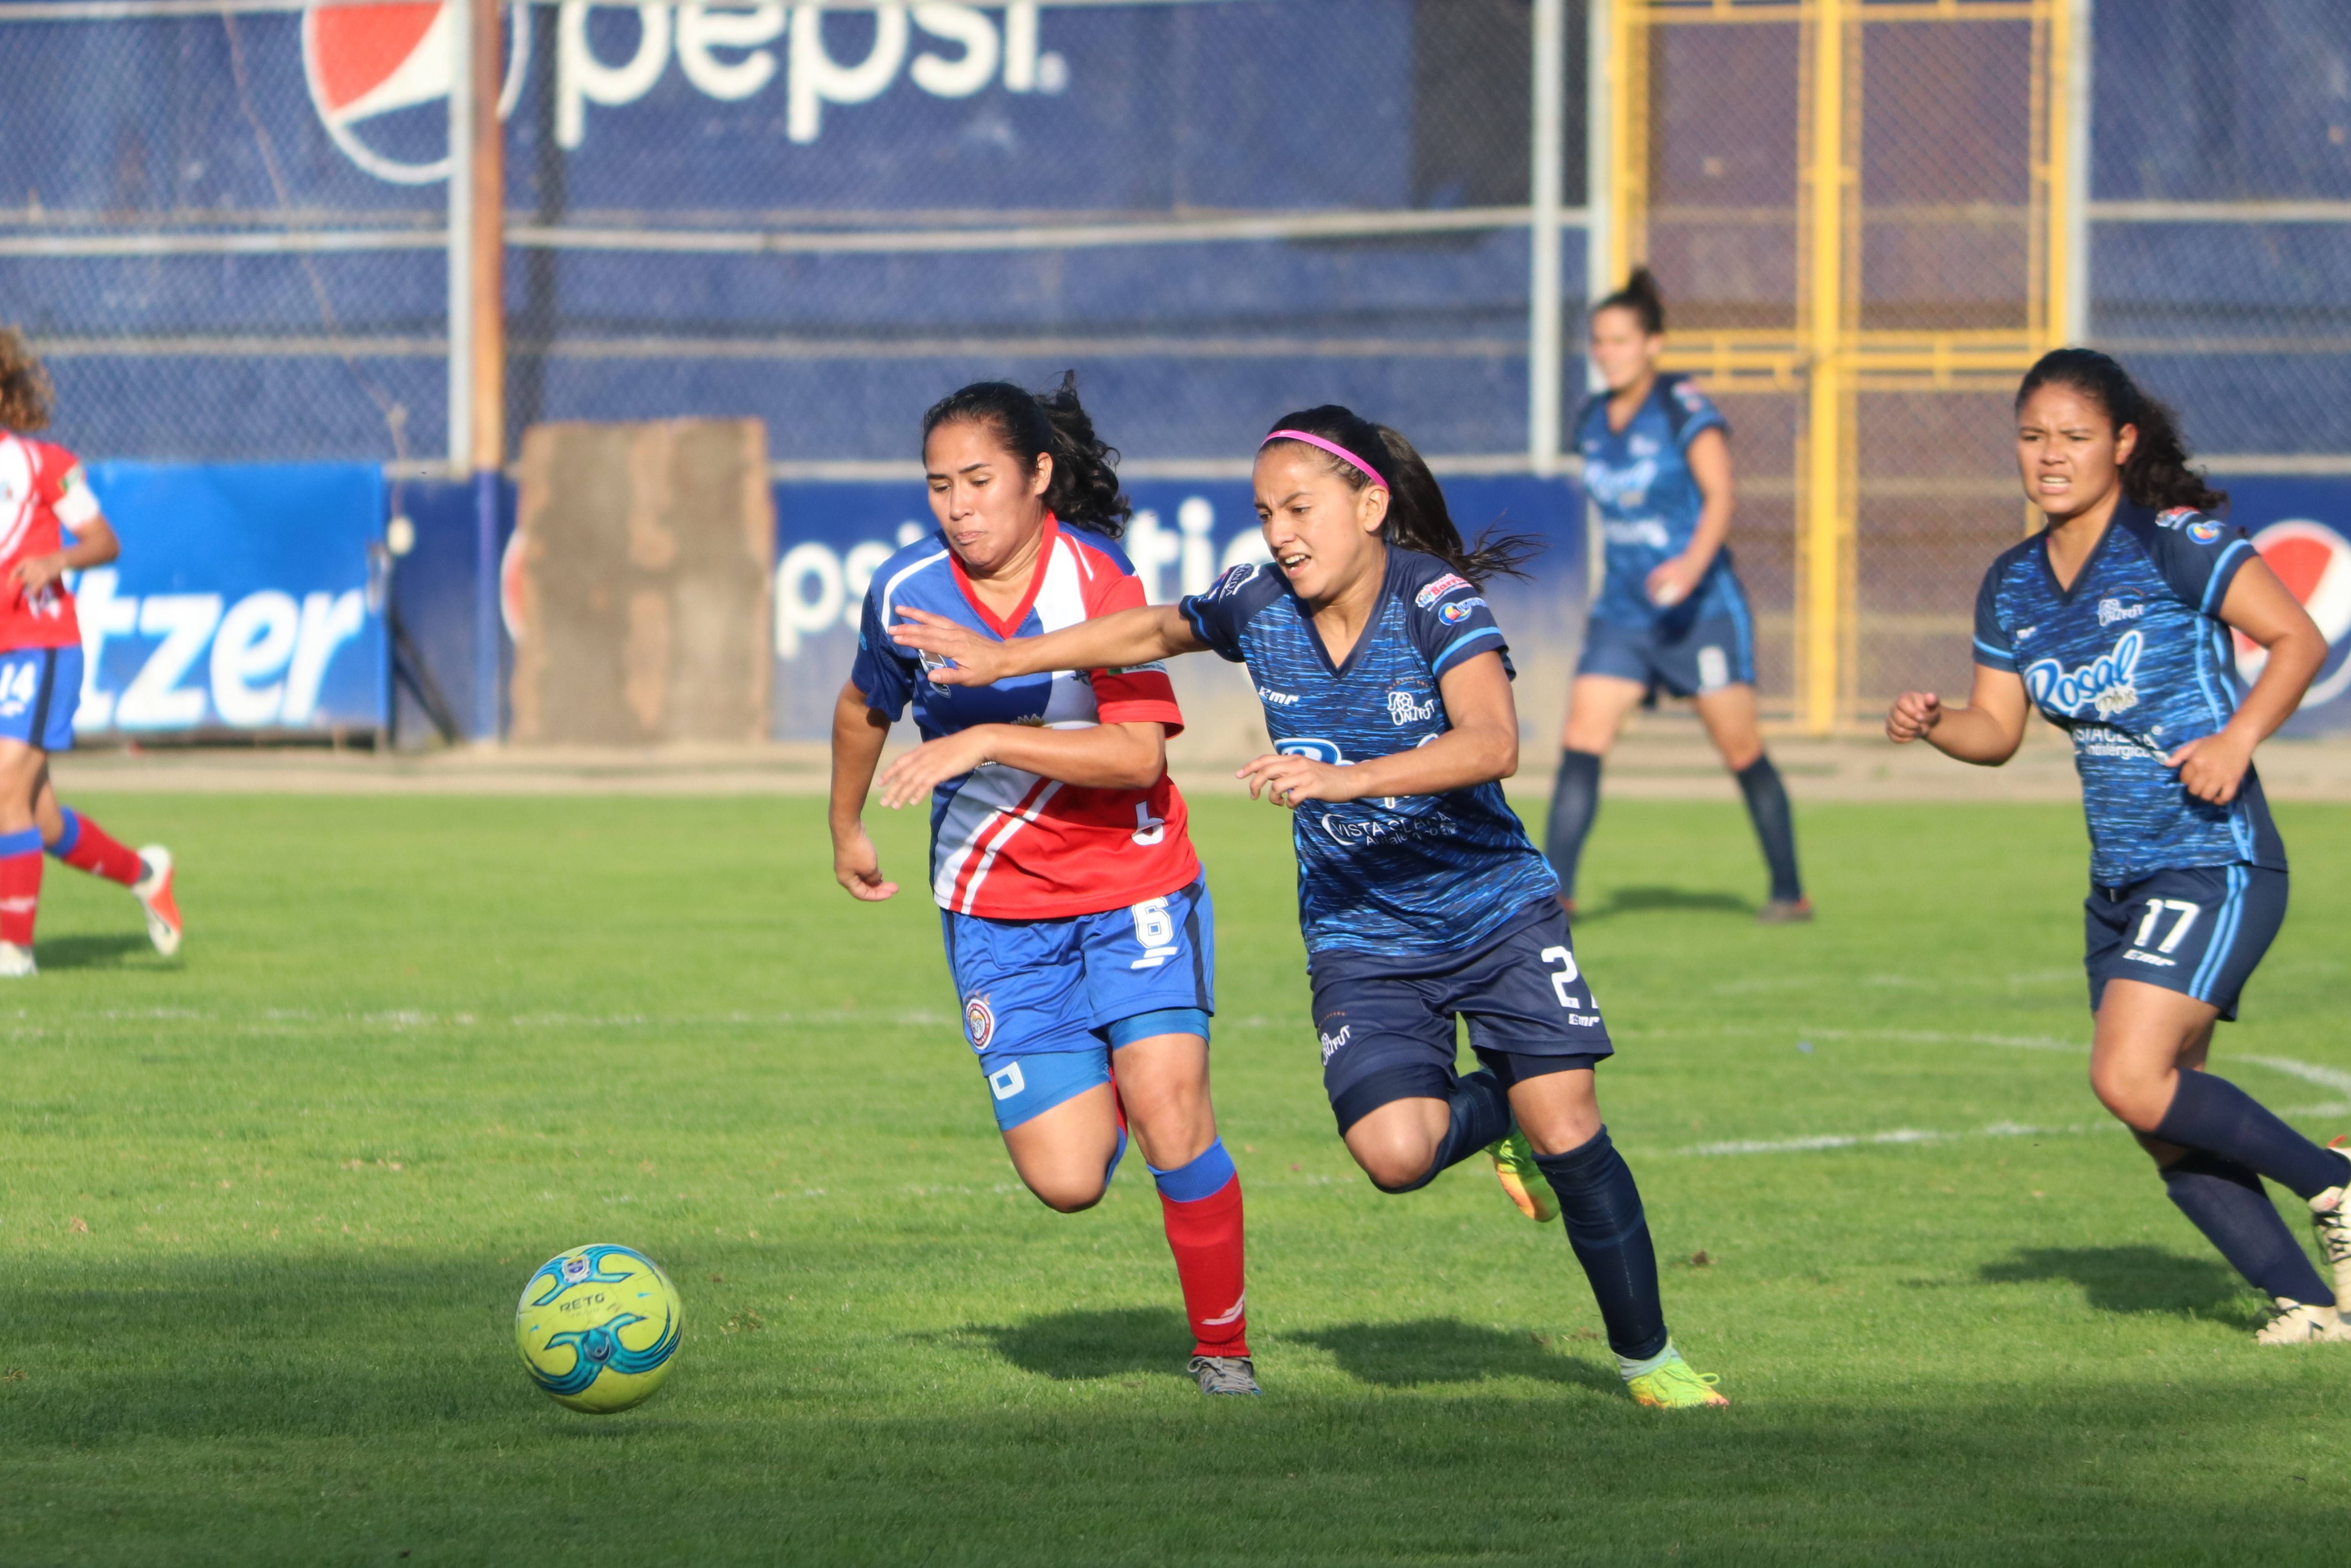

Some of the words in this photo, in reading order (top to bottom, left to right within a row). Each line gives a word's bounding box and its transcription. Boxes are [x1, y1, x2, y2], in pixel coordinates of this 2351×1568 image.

[0, 663, 36, 703] 14
[1132, 897, 1174, 949] 6
[2133, 898, 2200, 954] 17
[1541, 945, 1599, 1009] 2
